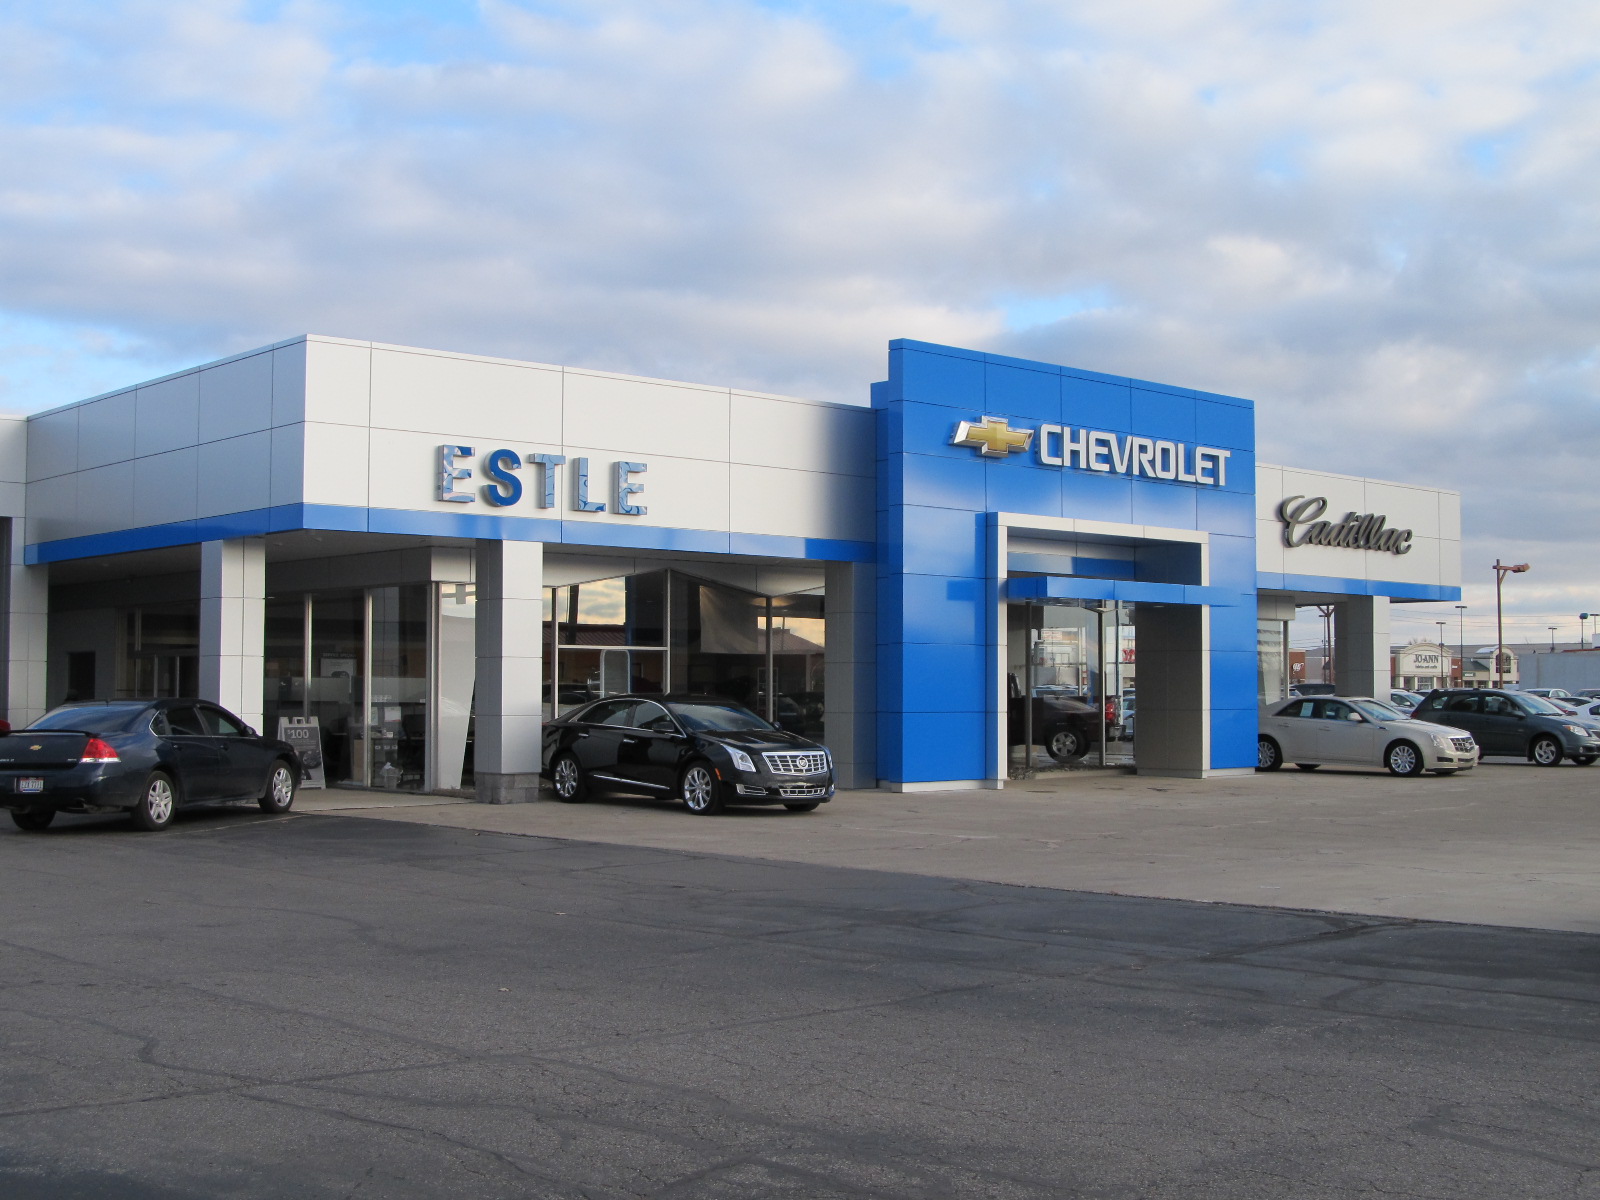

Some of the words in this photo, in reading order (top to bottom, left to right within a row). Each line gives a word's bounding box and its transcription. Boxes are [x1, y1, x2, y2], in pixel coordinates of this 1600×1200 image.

[437, 444, 648, 516] ESTLE
[1038, 423, 1231, 487] CHEVROLET
[1278, 494, 1413, 556] Cadillac
[287, 729, 309, 739] $100
